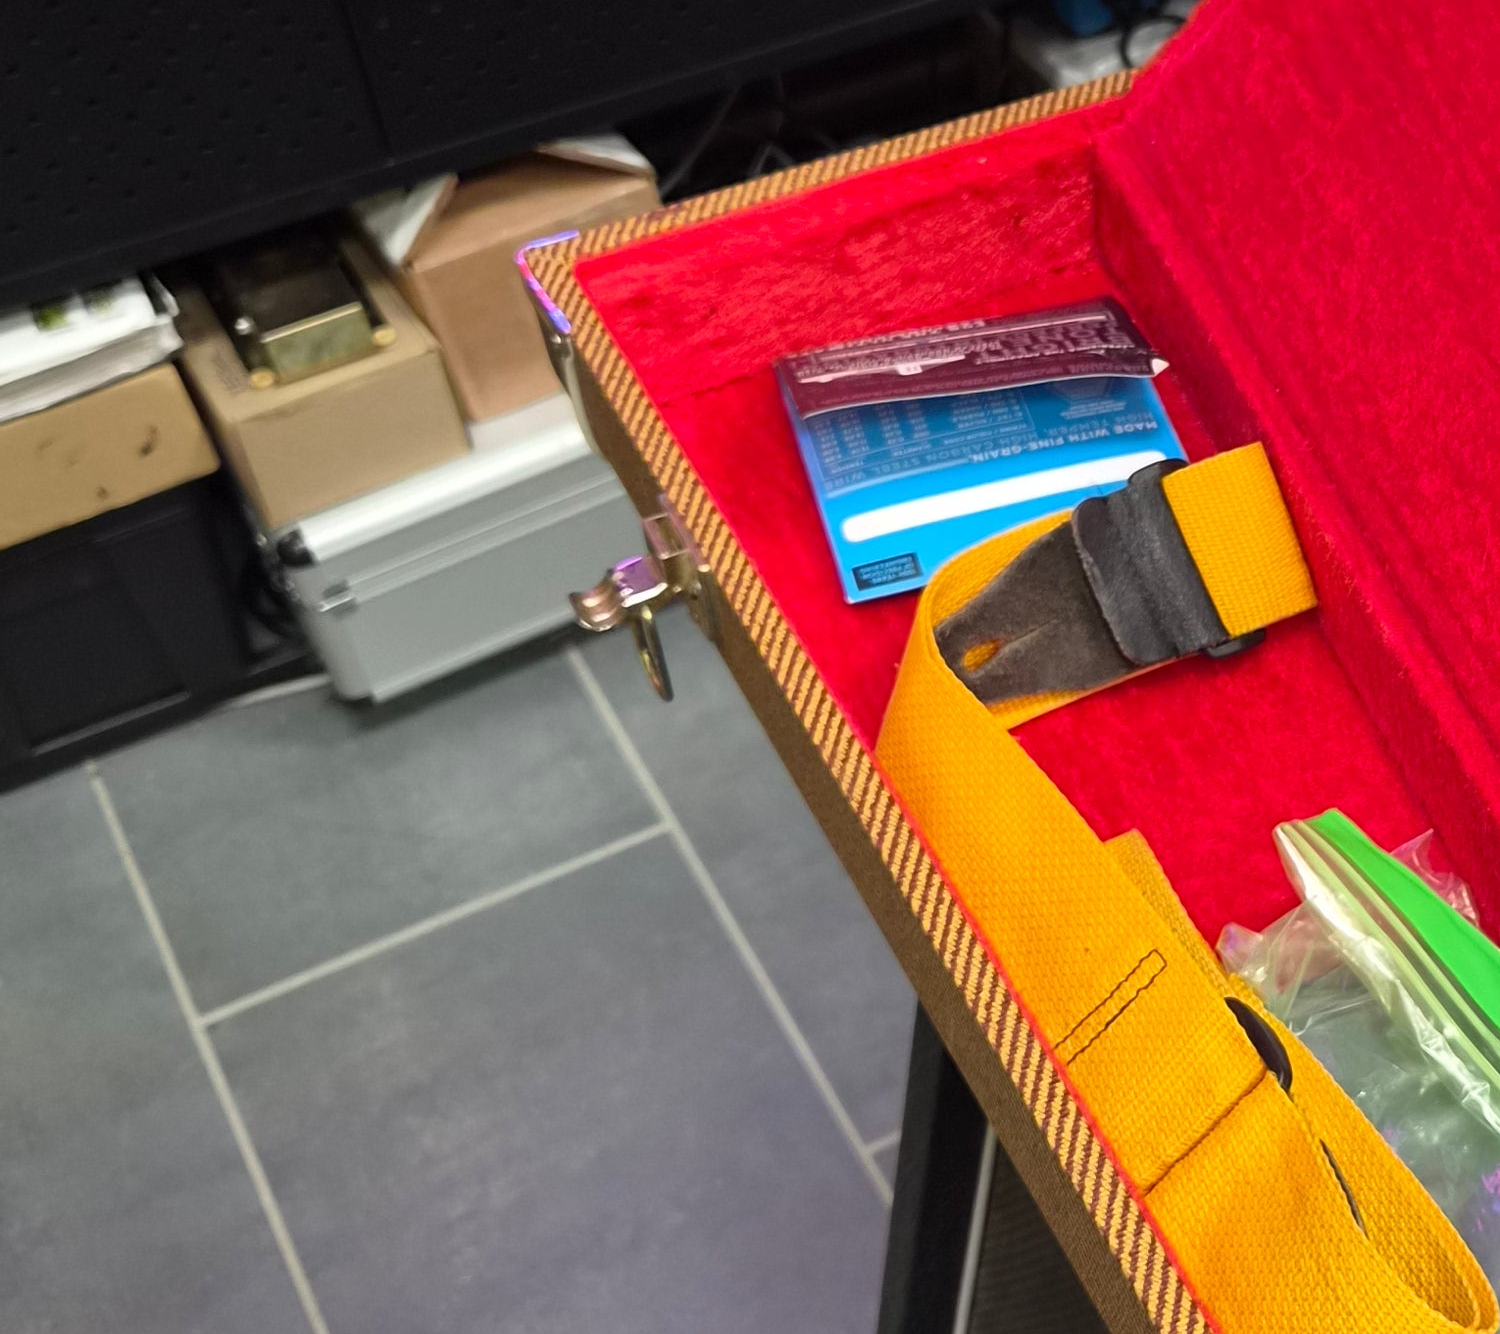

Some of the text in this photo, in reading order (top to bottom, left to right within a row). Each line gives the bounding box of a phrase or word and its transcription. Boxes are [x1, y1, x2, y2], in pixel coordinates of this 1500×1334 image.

[1068, 427, 1110, 443] WITH
[1113, 421, 1158, 435] MADE
[926, 442, 994, 463] CARBON
